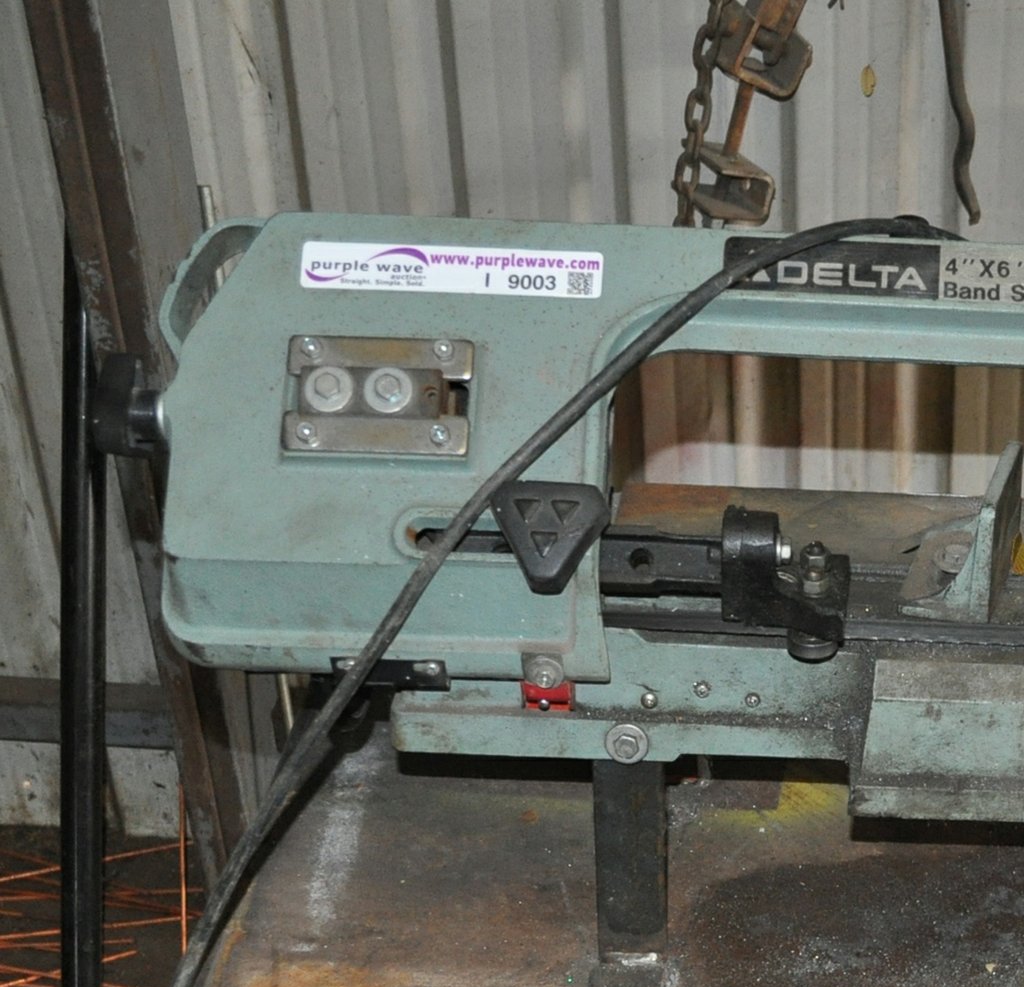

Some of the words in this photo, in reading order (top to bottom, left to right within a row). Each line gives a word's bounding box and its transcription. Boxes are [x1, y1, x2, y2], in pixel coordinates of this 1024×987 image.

[310, 260, 369, 273] purple
[376, 263, 424, 274] wave
[430, 252, 600, 272] www.purplewave.com
[508, 274, 557, 291] 9003
[777, 260, 928, 291] DELTA
[943, 281, 1001, 302] Band
